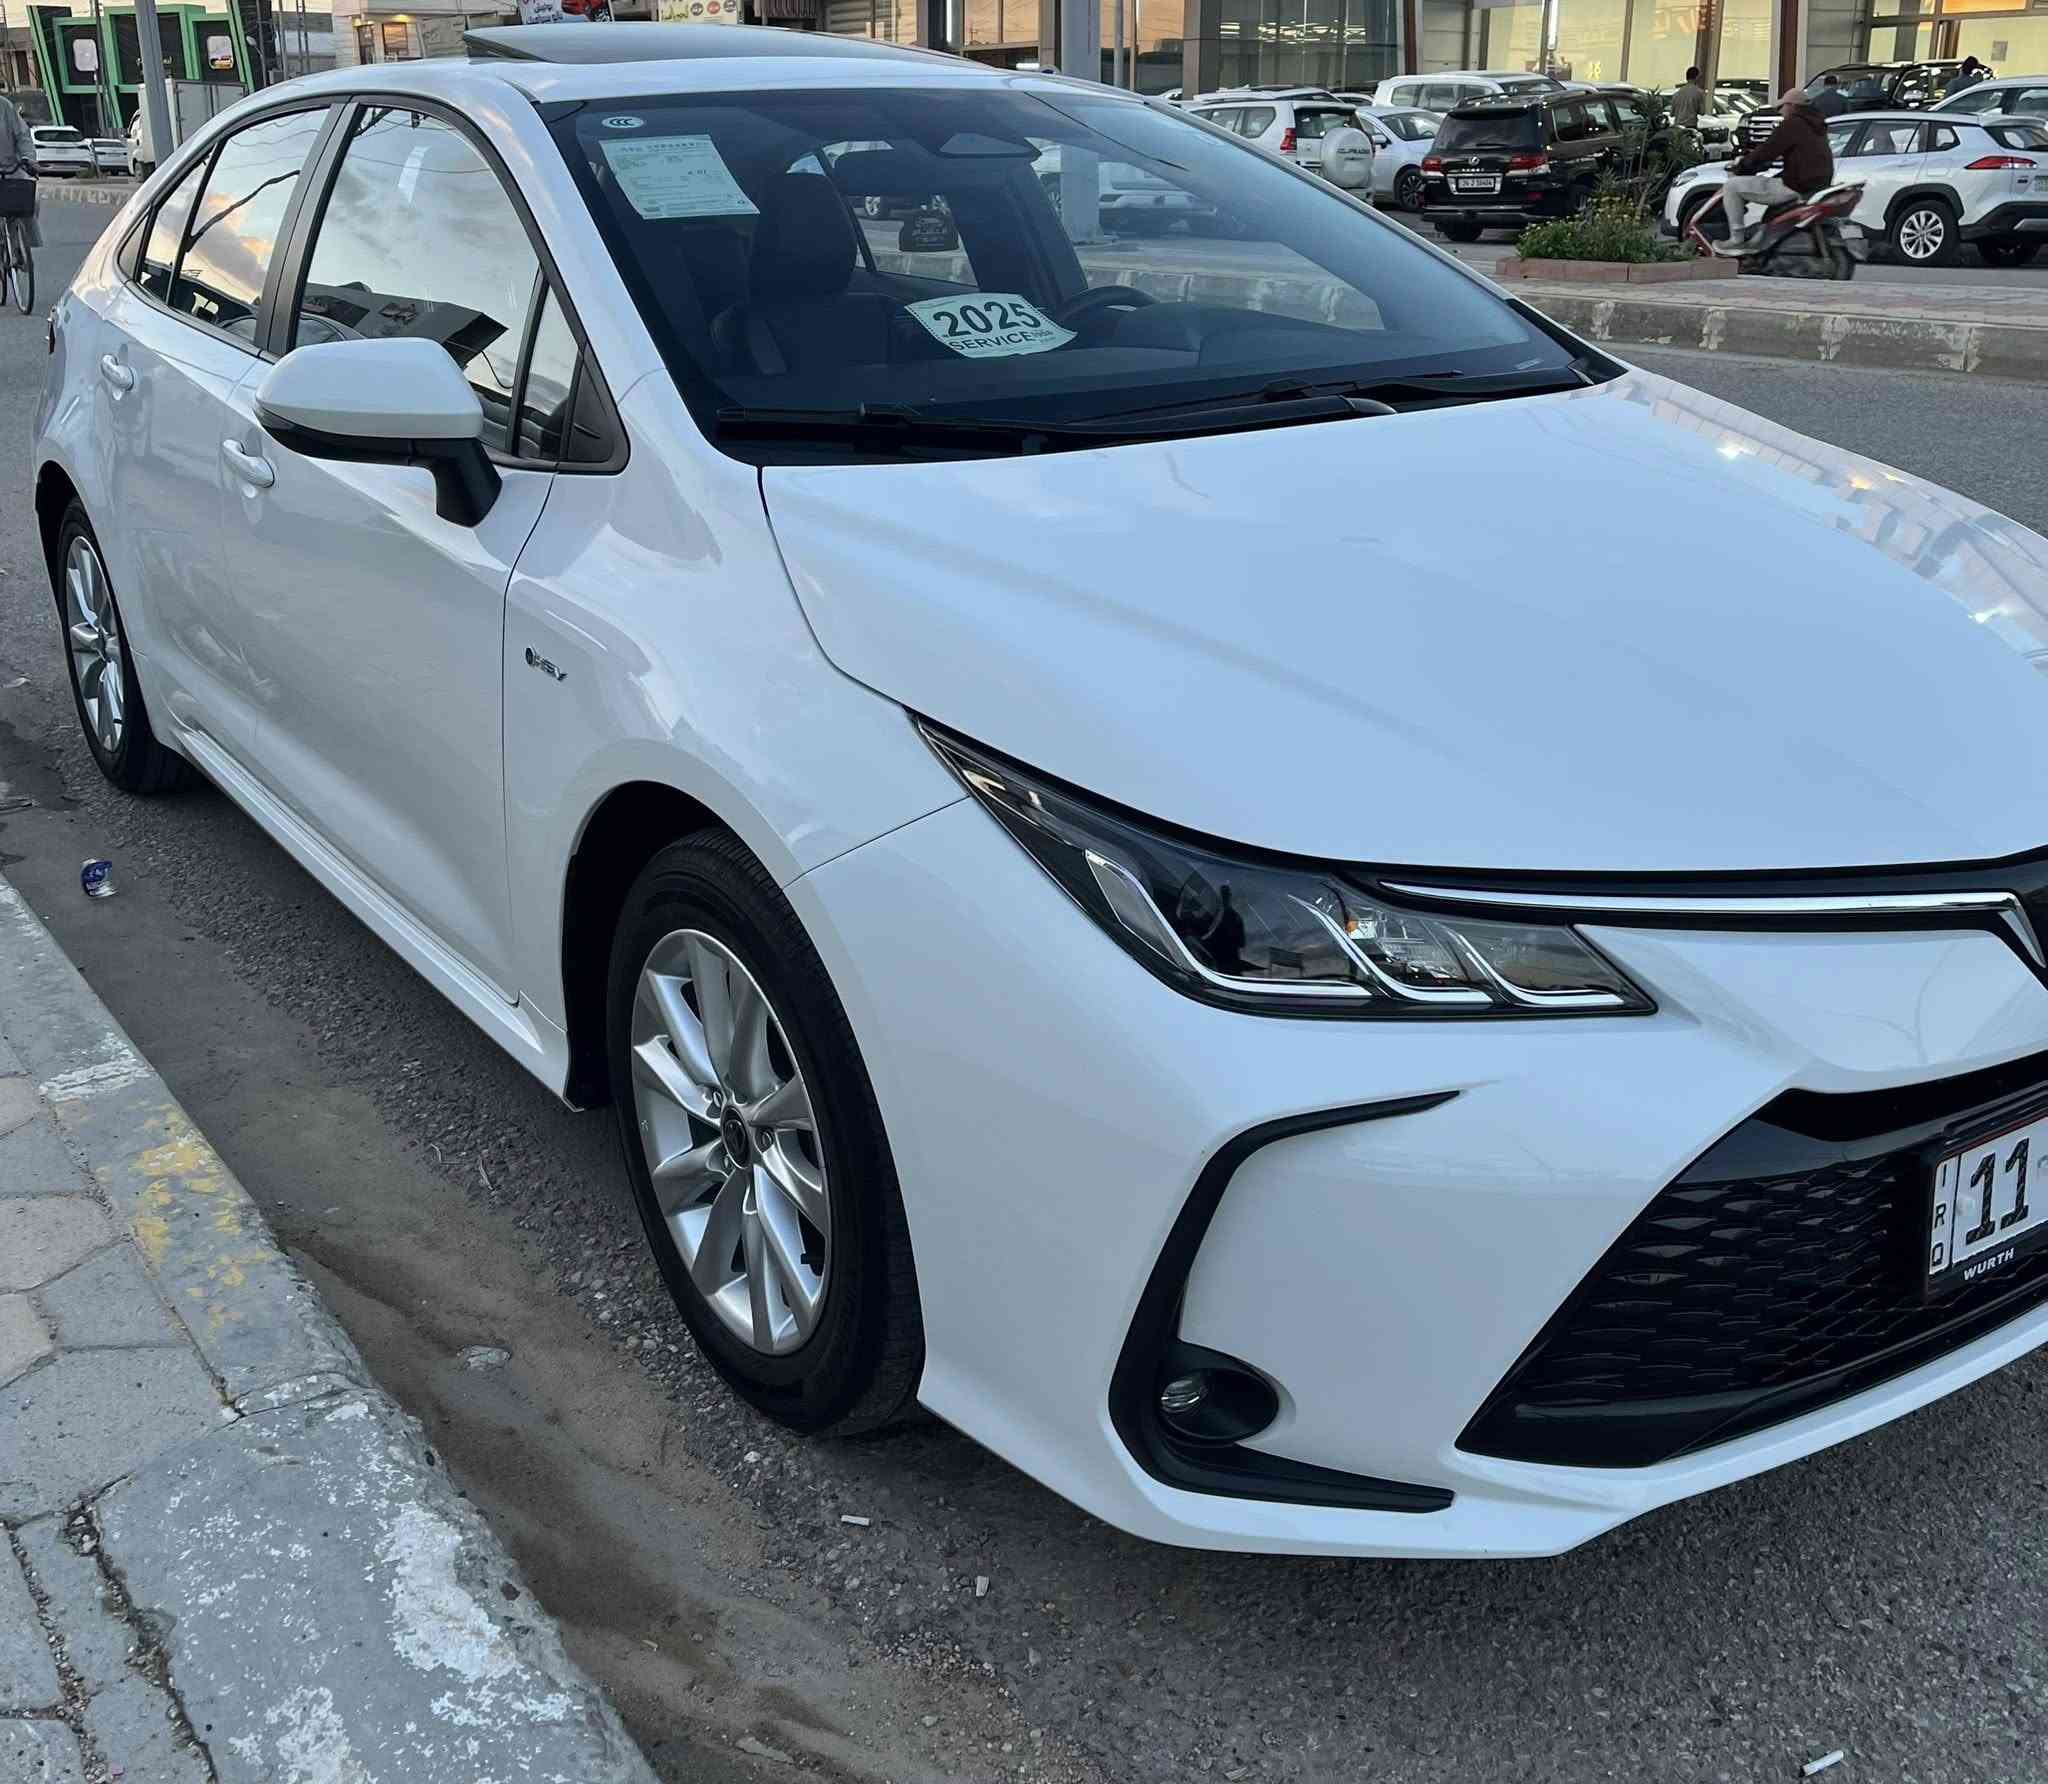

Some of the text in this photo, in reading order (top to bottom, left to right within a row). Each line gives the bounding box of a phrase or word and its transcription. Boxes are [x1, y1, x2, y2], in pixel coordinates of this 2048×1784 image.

[933, 301, 1041, 337] 2025
[948, 331, 1034, 351] SERVICE
[1966, 1137, 2030, 1245] 11
[1963, 1247, 2015, 1281] WURTH
